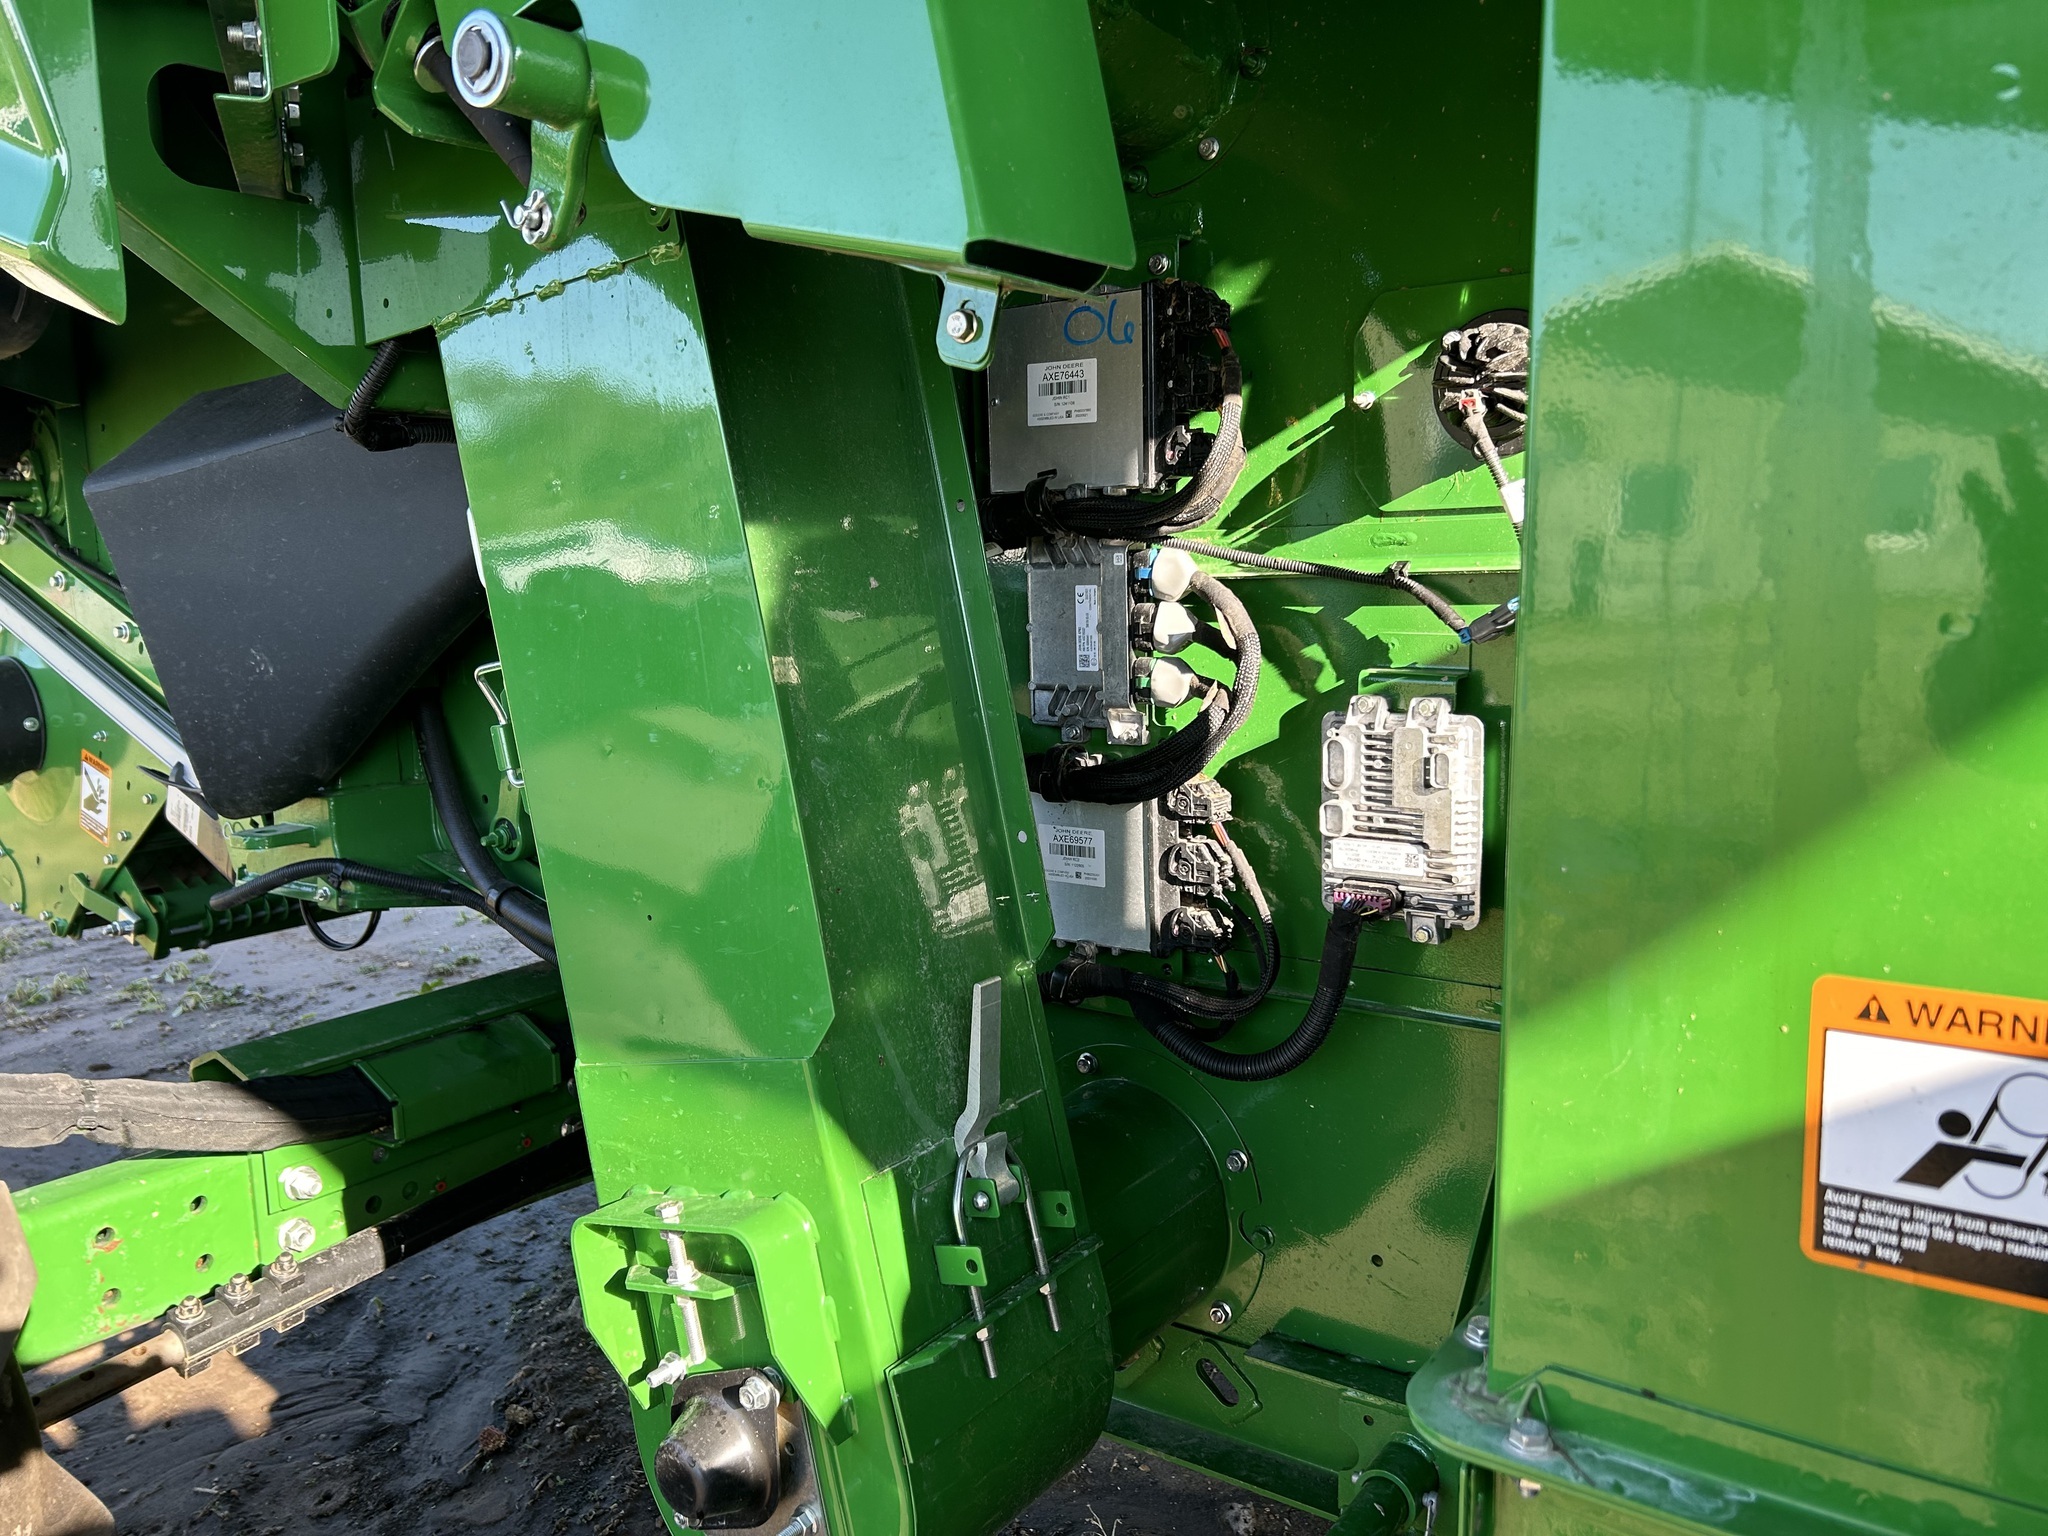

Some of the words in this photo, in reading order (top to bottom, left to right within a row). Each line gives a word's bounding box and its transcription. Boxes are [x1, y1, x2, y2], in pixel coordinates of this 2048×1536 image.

[1063, 299, 1135, 346] 06
[1042, 369, 1085, 382] AXE76443
[1053, 835, 1093, 845] AXE69577
[1824, 1188, 1860, 1208] Avoid
[1862, 1198, 1912, 1218] serious
[1912, 1205, 1953, 1228] injury
[1953, 1212, 1987, 1233] from
[1822, 1218, 1854, 1238] Stop
[1854, 1226, 1900, 1247] engine
[1900, 1235, 1928, 1253] and
[1822, 1235, 1871, 1257] remove
[1823, 1205, 1857, 1223] raise
[1858, 1212, 1899, 1232] shield
[1900, 1221, 1931, 1237] with
[1931, 1224, 1955, 1243] the
[1956, 1230, 2005, 1254] engine
